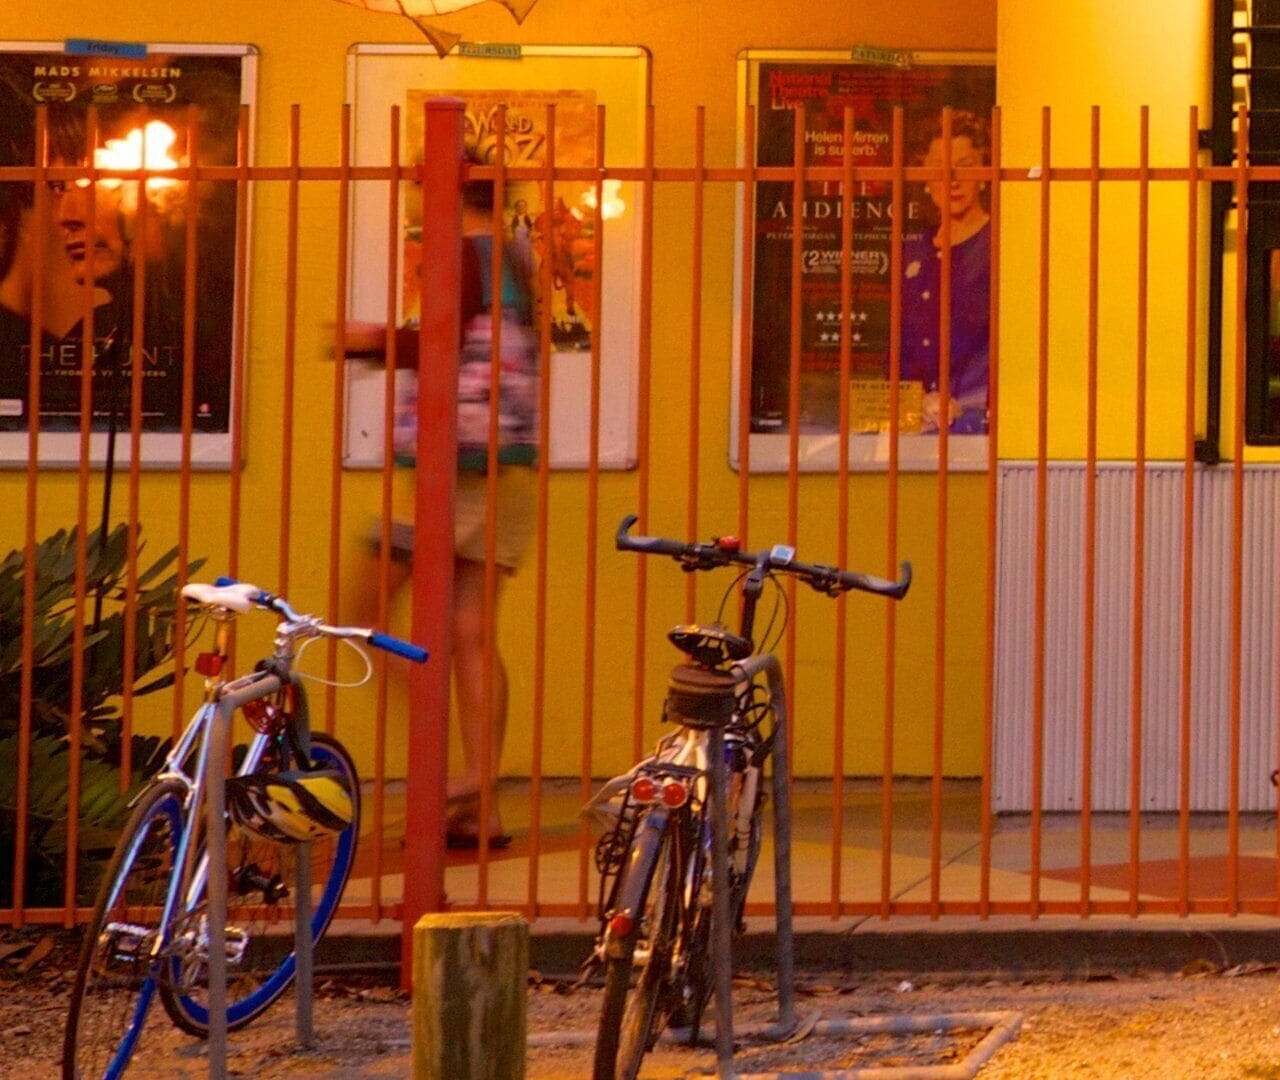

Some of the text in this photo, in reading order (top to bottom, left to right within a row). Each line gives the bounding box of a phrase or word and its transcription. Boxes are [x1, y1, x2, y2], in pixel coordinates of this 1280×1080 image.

[33, 66, 182, 78] MADS MIKKELSEN
[805, 130, 843, 144] Helen
[813, 144, 826, 156] is
